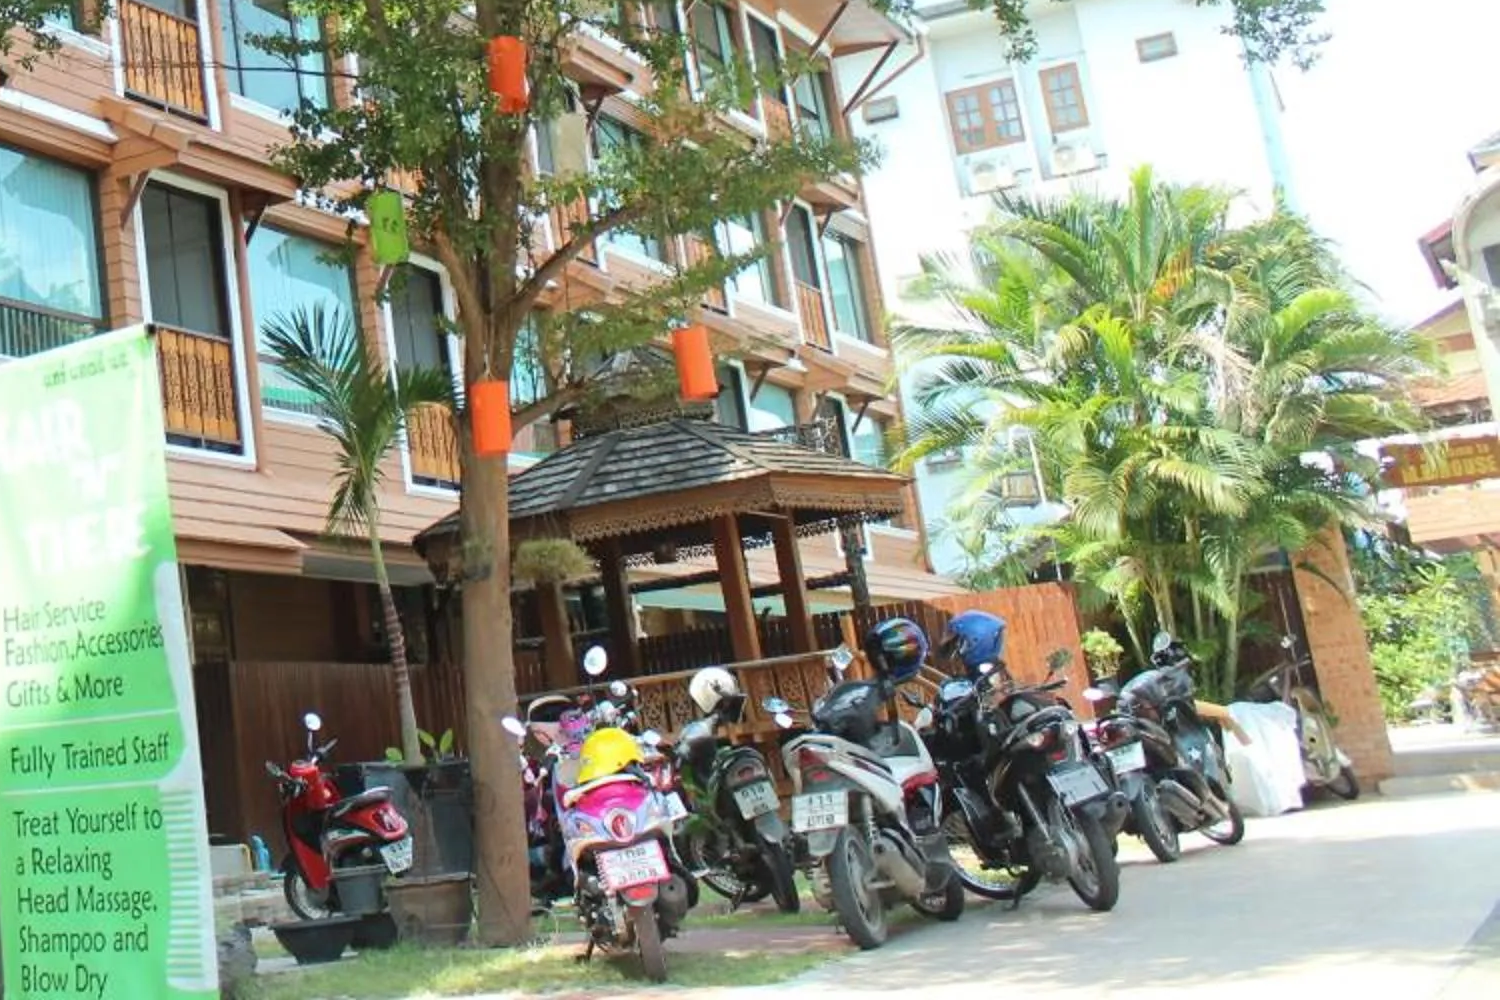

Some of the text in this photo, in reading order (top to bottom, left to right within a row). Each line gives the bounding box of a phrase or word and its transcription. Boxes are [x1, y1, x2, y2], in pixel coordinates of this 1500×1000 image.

[3, 597, 106, 633] Hair Service
[6, 672, 124, 708] Gifts & More
[10, 731, 170, 779] Fully Trained Staff
[13, 802, 164, 838] Treat Yourself to
[15, 846, 114, 881] a Relaxing
[17, 886, 69, 915] Head
[19, 923, 150, 960] Shampoo and
[21, 963, 109, 998] Blow Dry
